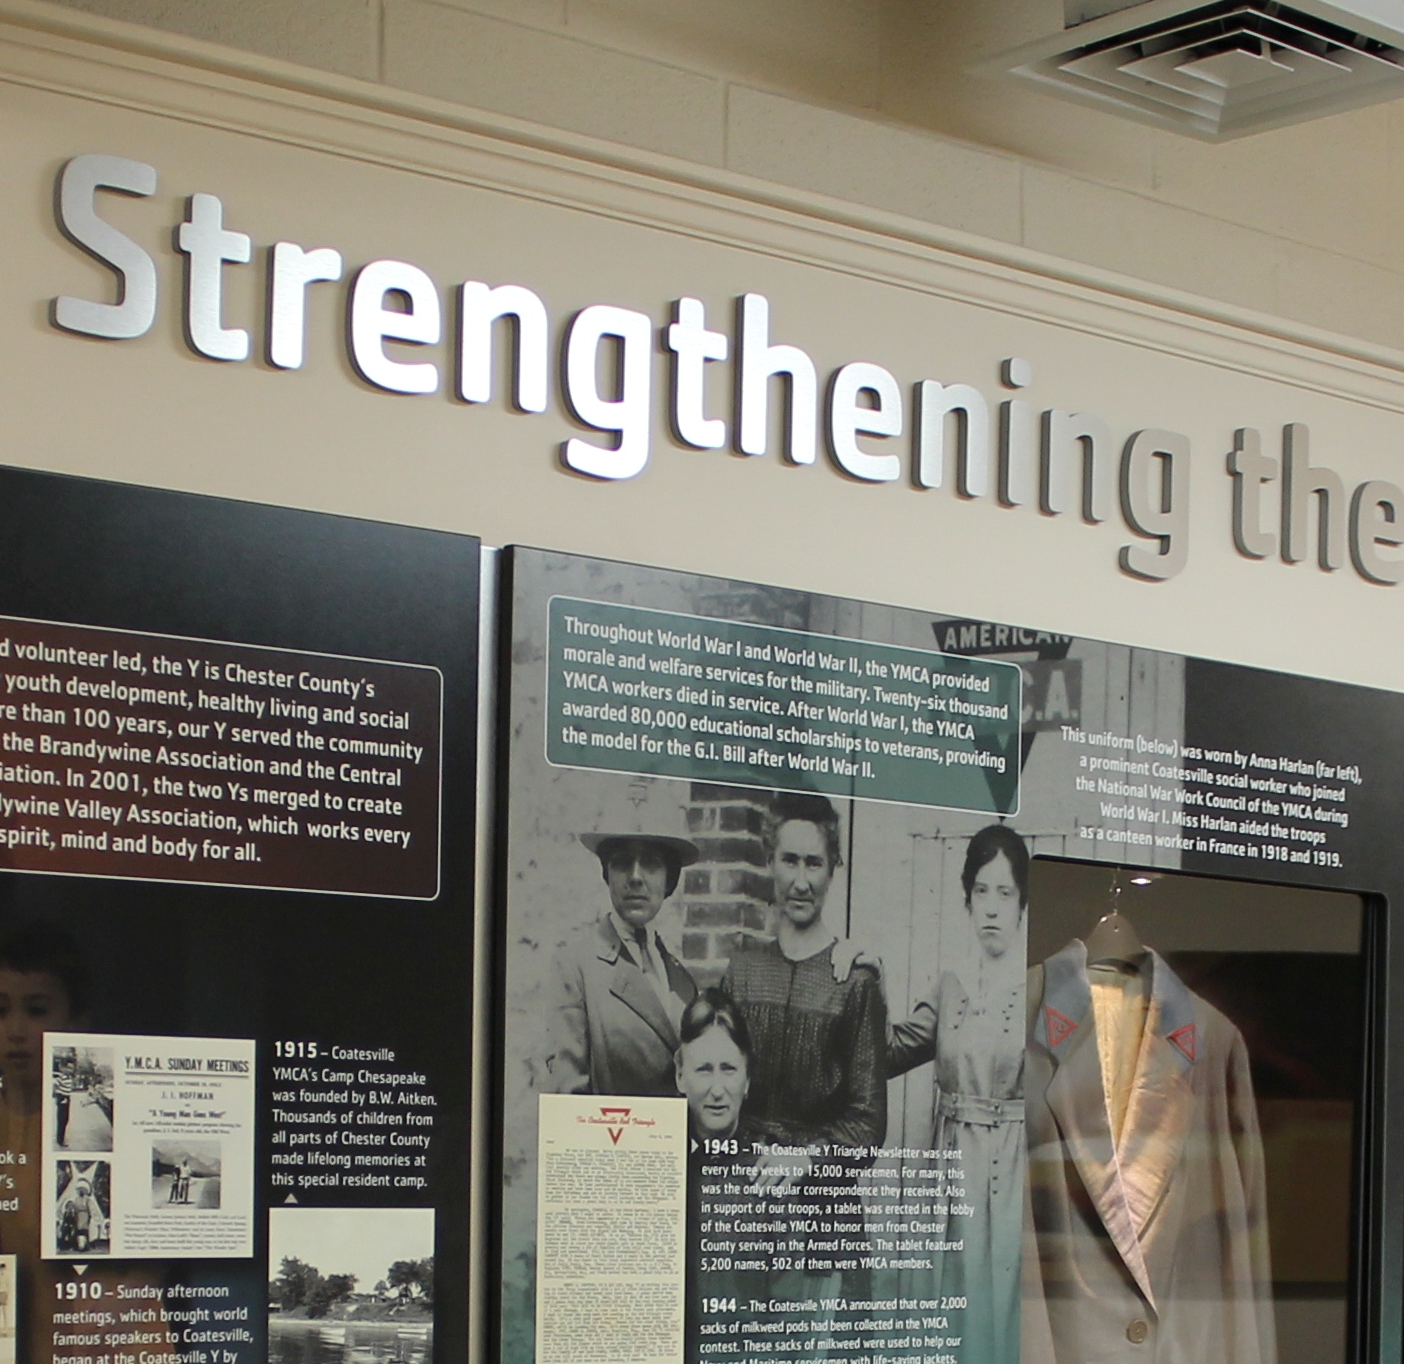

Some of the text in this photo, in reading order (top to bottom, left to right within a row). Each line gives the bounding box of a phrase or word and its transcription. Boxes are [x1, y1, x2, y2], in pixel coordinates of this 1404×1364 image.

[51, 153, 1190, 580] Strengthening
[14, 640, 109, 668] volunteer
[112, 649, 148, 676] led,
[151, 654, 183, 677] the
[186, 657, 201, 678] Y
[204, 659, 220, 681] is
[224, 662, 295, 688] Chester
[298, 671, 375, 701] County's
[561, 725, 876, 779] the model for the G.I. Bill after World War II.
[124, 1055, 249, 1073] Y.M.C.A. SUNDAY MEETINGS
[700, 1255, 934, 1273] 5,200 names, 502 of them were YMCA members.
